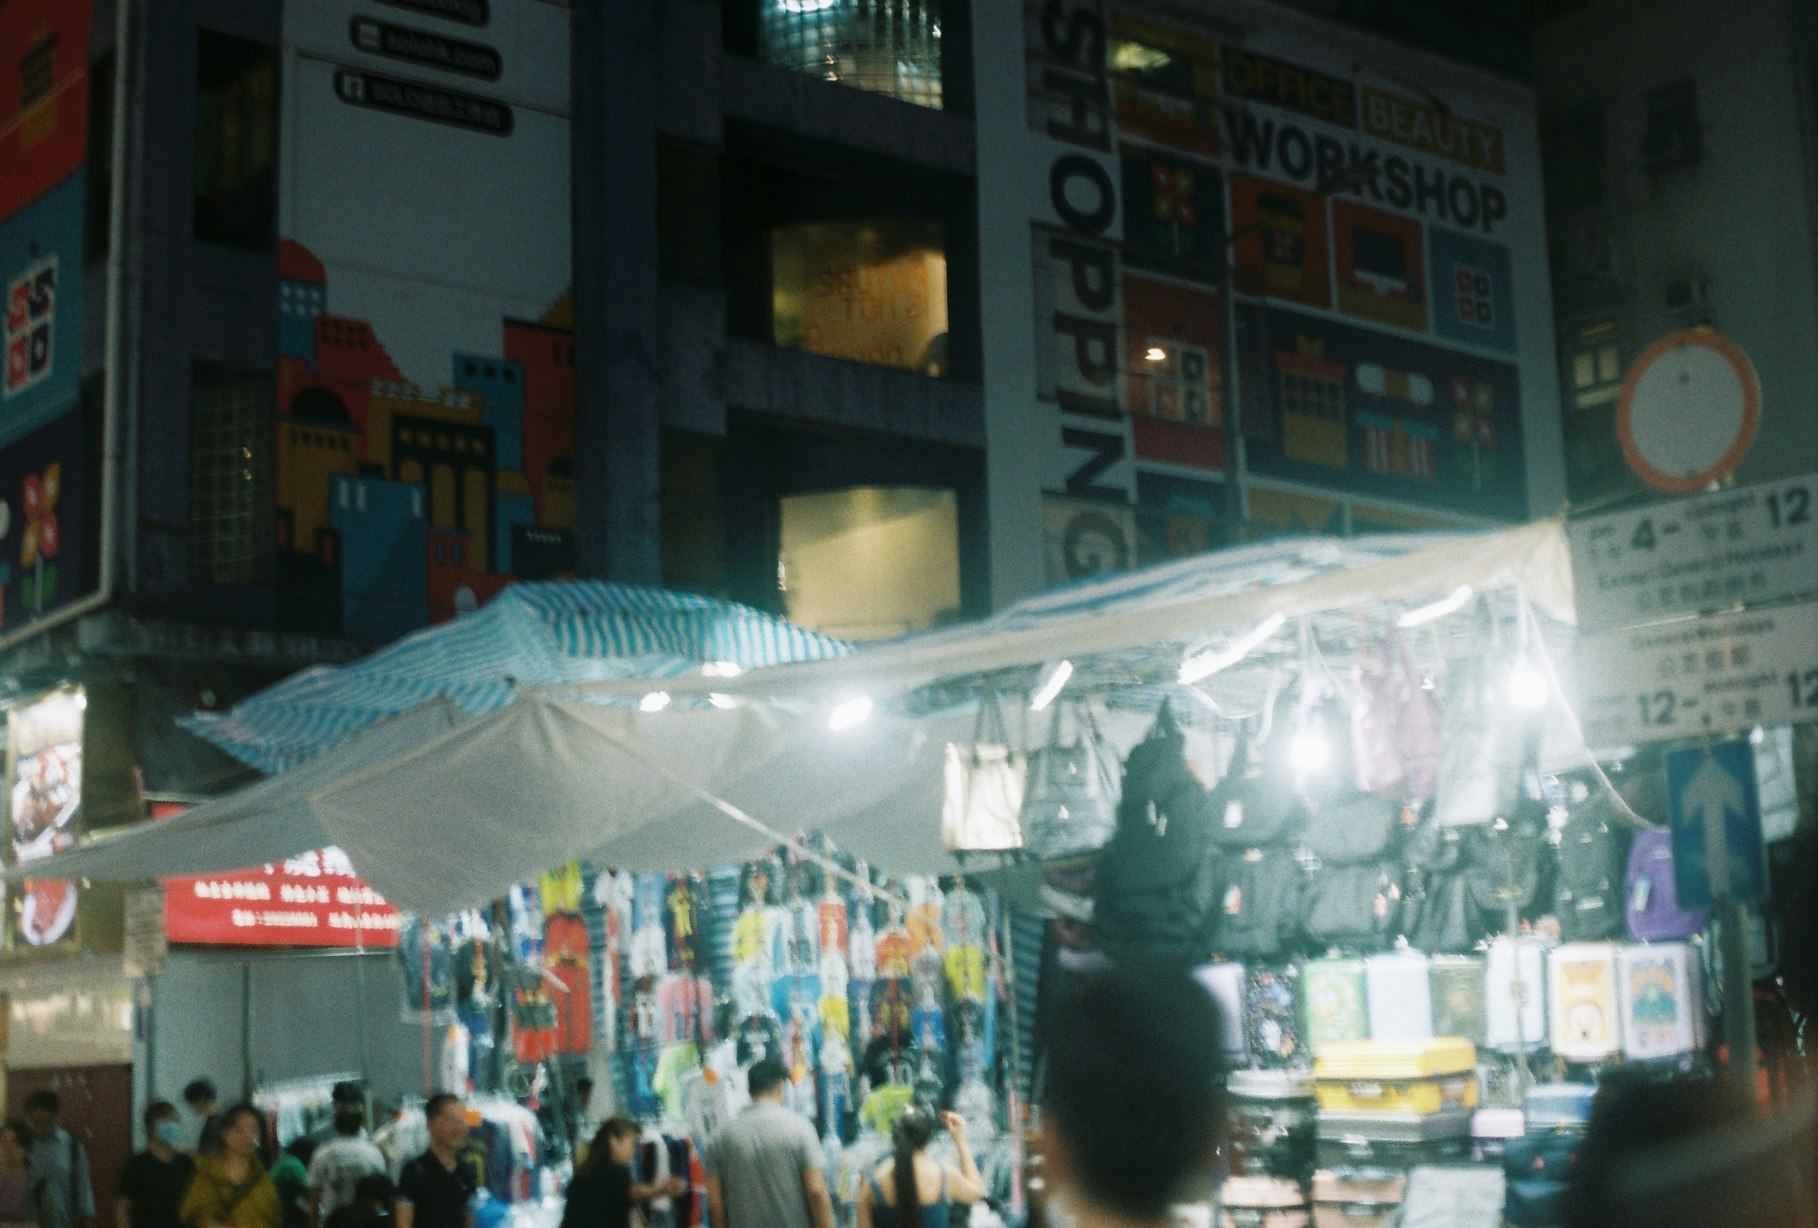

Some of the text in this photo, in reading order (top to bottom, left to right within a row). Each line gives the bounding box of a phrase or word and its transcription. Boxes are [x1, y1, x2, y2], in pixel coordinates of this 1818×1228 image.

[1227, 51, 1496, 163] OFFICE BEAUTY
[1224, 107, 1507, 232] WORKSHOP
[1042, 0, 1130, 585] SHOPPING
[1767, 486, 1811, 527] 12
